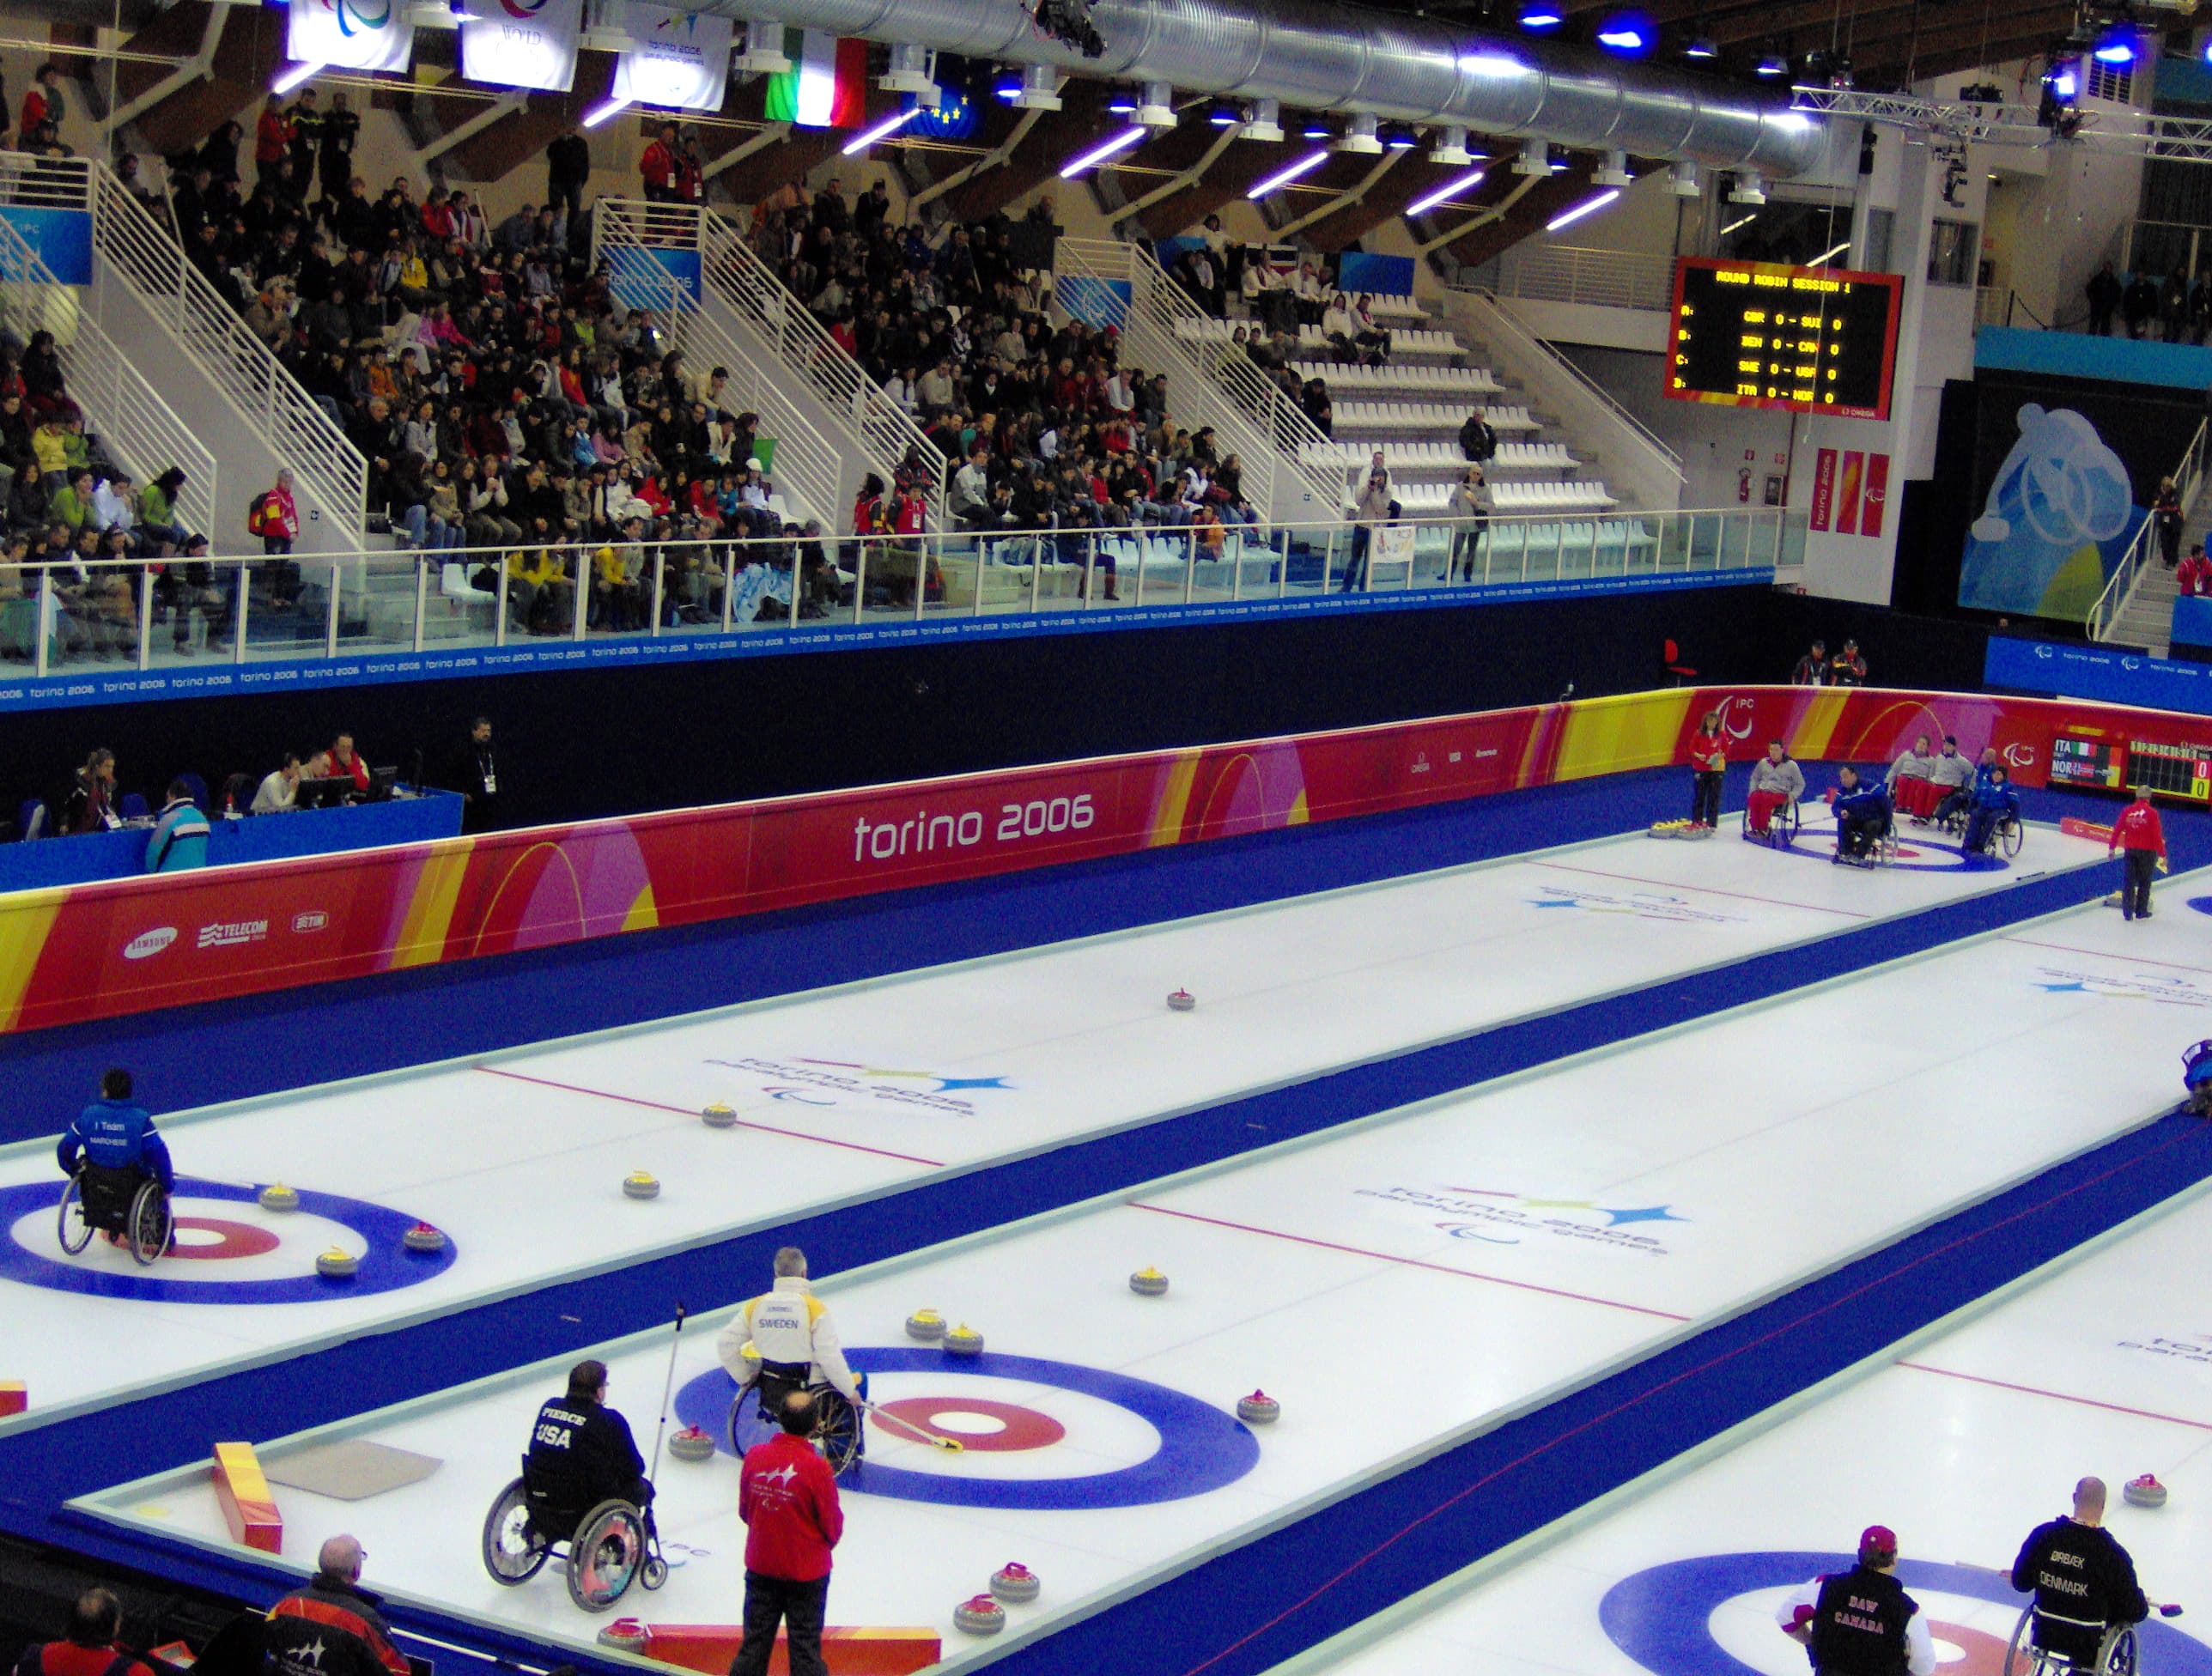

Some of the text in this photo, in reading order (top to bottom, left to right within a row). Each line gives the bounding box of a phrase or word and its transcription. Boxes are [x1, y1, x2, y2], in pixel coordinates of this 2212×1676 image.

[1716, 270, 1850, 294] ROUND ROBIN SESSION 1
[1736, 384, 1758, 396] ITA
[30, 688, 64, 698] torino
[104, 682, 136, 692] torino
[172, 677, 203, 688] torino
[240, 672, 270, 682] torino
[1735, 698, 1754, 708] IPC
[2055, 738, 2071, 753] ITA
[2052, 759, 2072, 774] NOR
[2198, 762, 2207, 778] 0
[2197, 780, 2205, 797] 0
[854, 794, 1095, 862] torino 2006
[223, 920, 268, 938] TELECOM
[758, 1318, 799, 1329] SWEDEN
[542, 1407, 587, 1426] PIERCE
[536, 1424, 572, 1449] USA
[2040, 1570, 2089, 1597] DENMARK
[1834, 1612, 1884, 1635] CANADA
